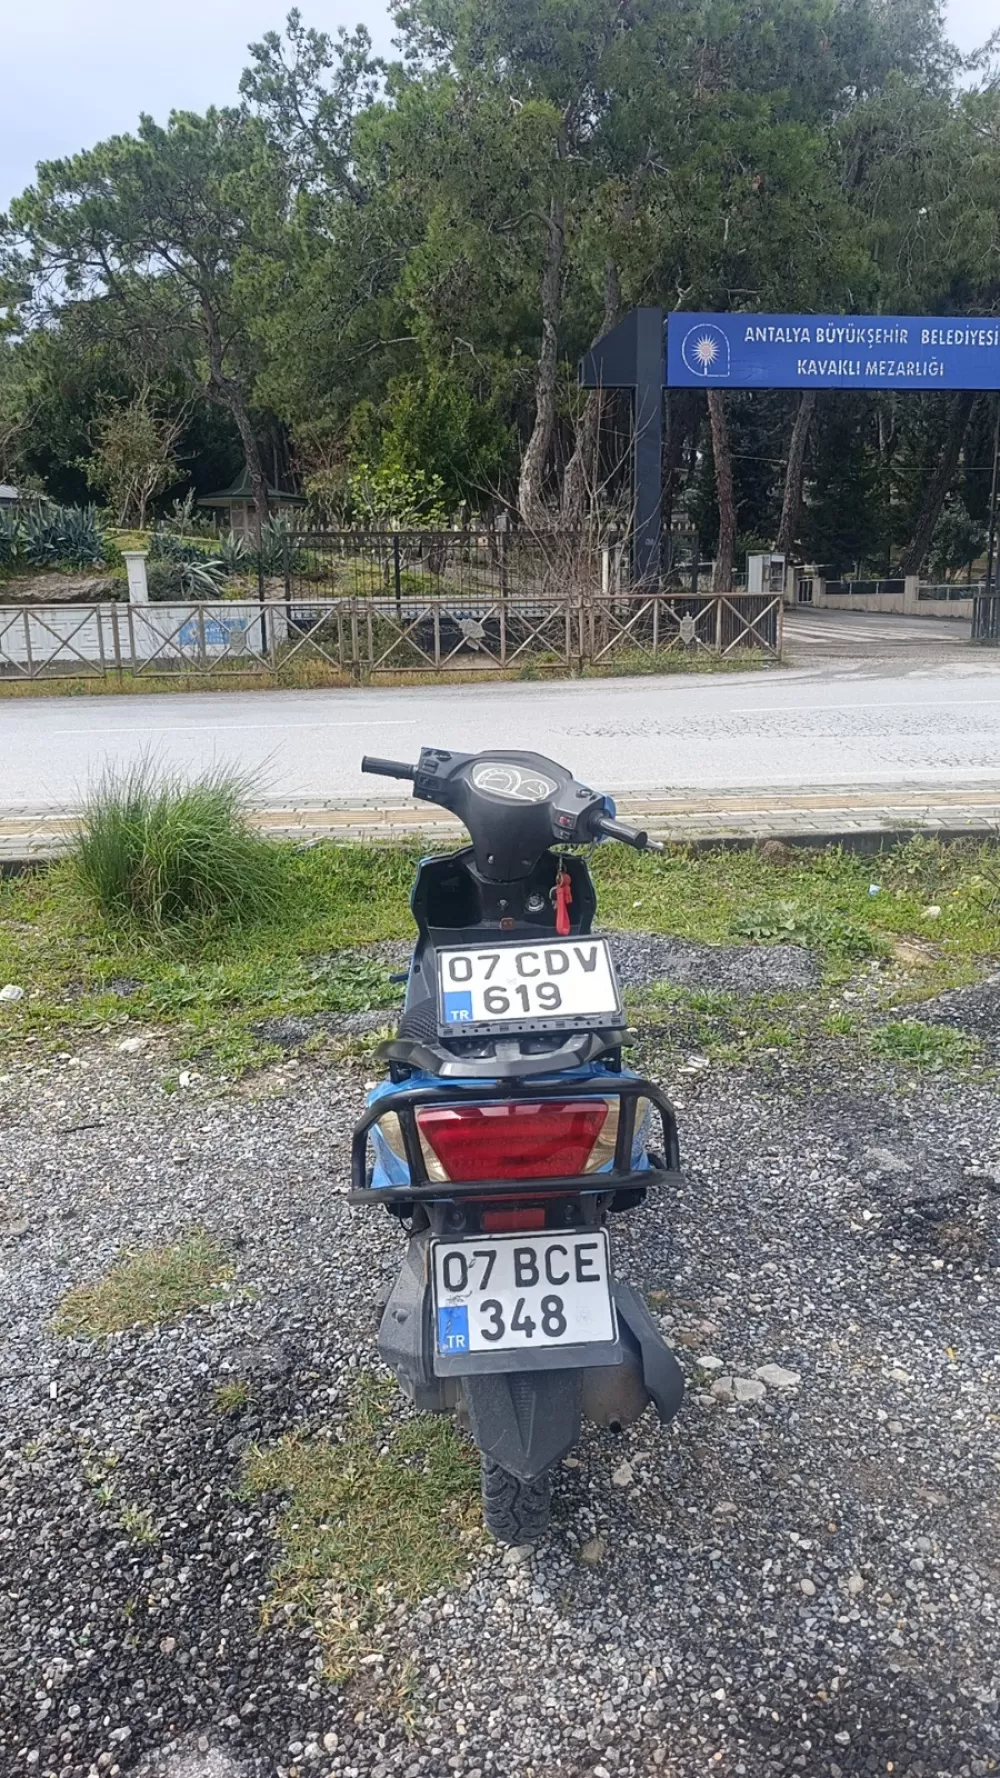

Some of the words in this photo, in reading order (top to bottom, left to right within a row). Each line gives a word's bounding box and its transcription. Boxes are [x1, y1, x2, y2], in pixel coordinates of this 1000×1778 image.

[744, 326, 811, 344] ANTALYA
[816, 322, 908, 349] BÜYÜKŞEHİR
[921, 324, 999, 346] BELEDİYESİ
[797, 358, 860, 376] KAVAKLI
[865, 356, 944, 377] MEZARLIĞI
[448, 953, 501, 982] 07
[515, 946, 598, 978] CDV
[483, 981, 563, 1015] 619
[451, 1009, 469, 1020] TR
[442, 1249, 497, 1292] 07
[513, 1242, 601, 1288] BCE
[479, 1294, 567, 1342] 348
[447, 1334, 465, 1348] TR
